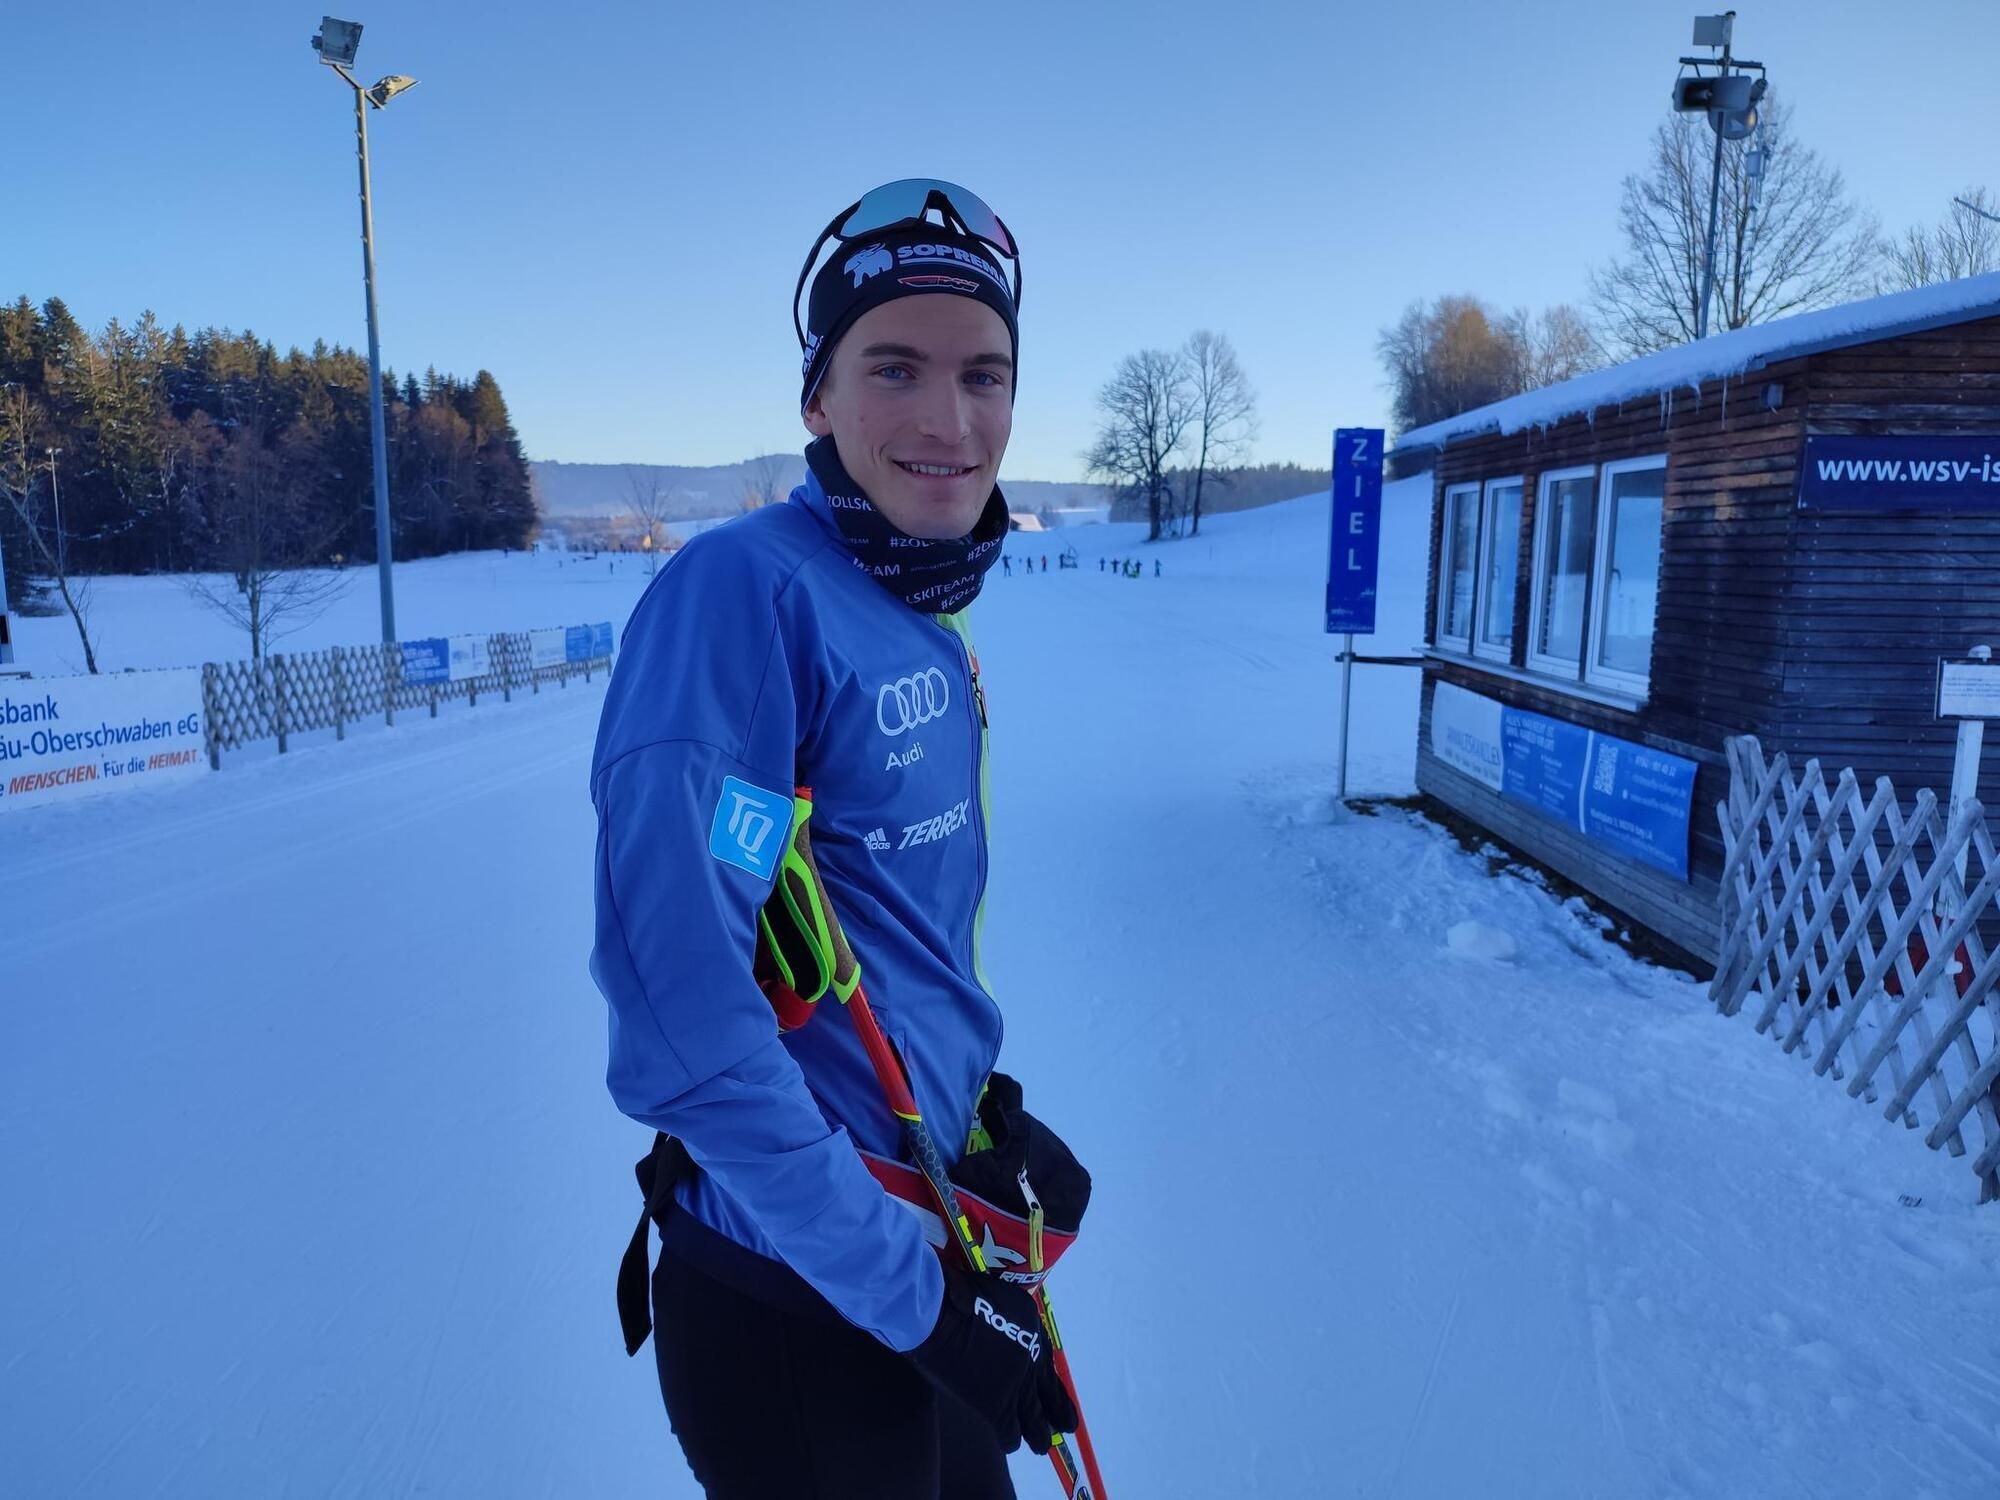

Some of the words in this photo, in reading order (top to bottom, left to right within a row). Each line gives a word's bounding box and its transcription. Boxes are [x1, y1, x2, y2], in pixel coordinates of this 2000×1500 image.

[1817, 454, 2000, 483] www.wsv-is
[1347, 438, 1368, 570] ZIEL
[177, 713, 199, 735] eG
[885, 742, 924, 771] Audi
[9, 764, 100, 795] MENSCHEN.
[103, 760, 124, 778] Für
[127, 757, 145, 774] die
[897, 798, 970, 850] TERREX
